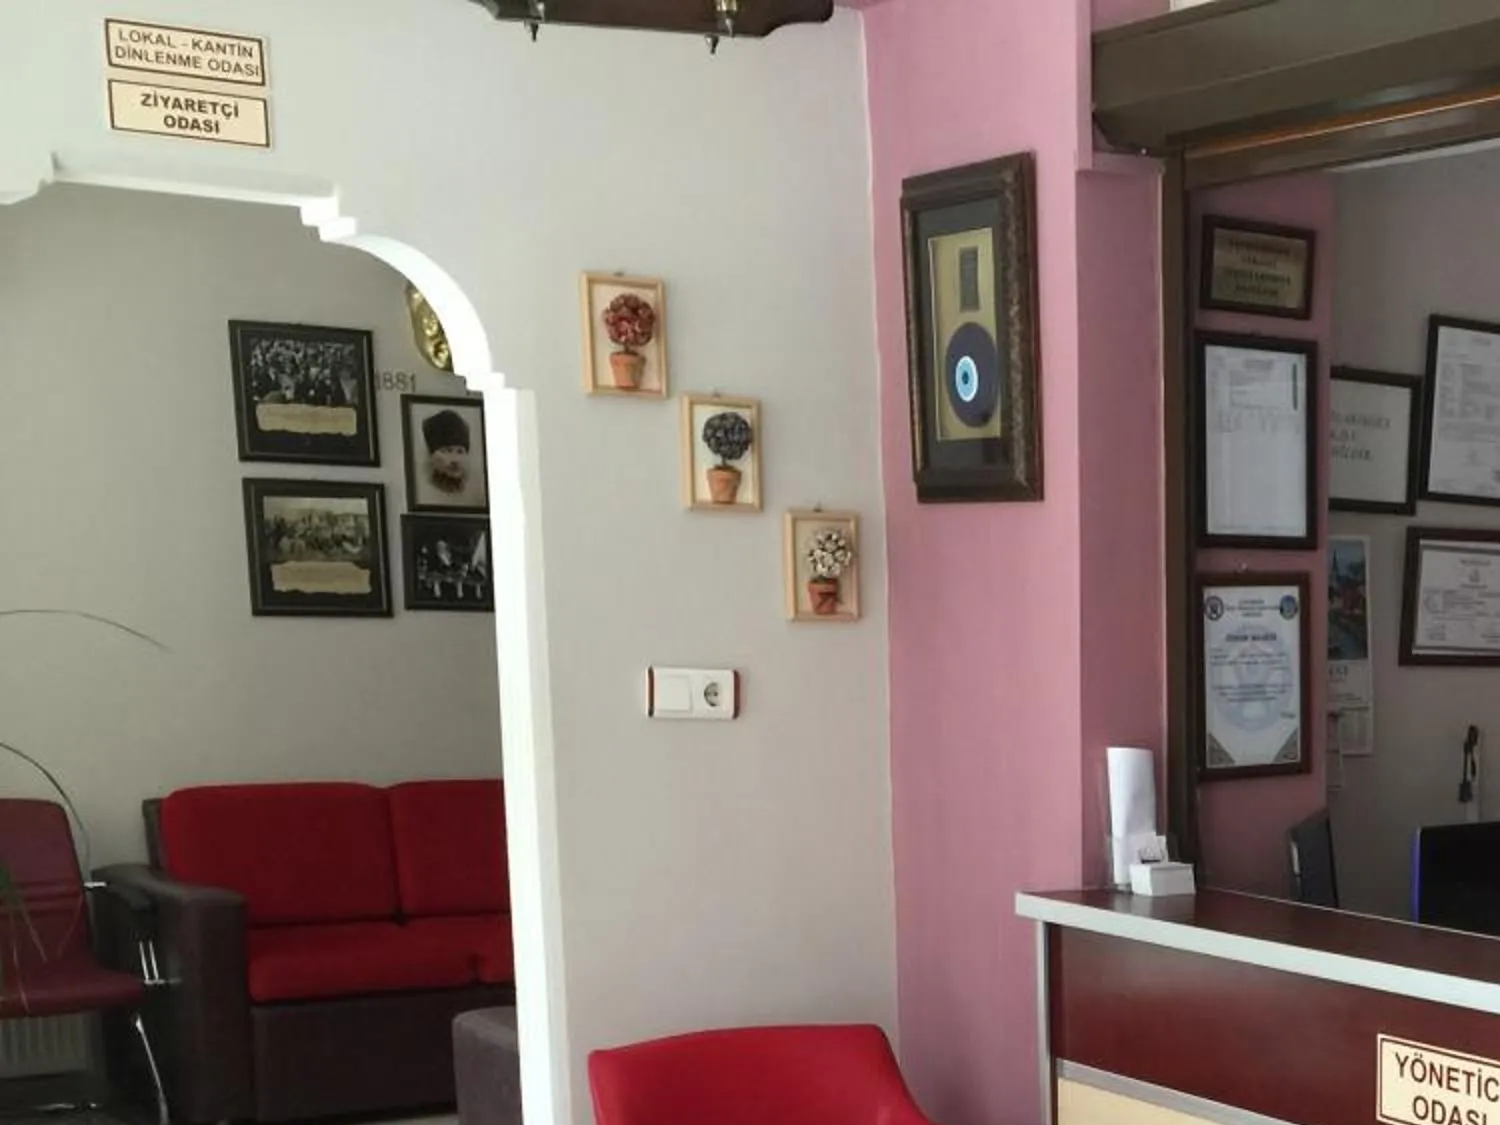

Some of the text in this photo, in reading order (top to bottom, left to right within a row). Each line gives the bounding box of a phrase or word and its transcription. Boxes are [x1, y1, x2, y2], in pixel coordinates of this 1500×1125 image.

[118, 28, 176, 49] LOKAL
[191, 38, 254, 59] KANTİN
[114, 44, 260, 77] DİNLENME ODASI
[140, 90, 239, 120] ZİYARETÇİ
[163, 115, 220, 134] ODASI
[375, 370, 417, 392] 1881
